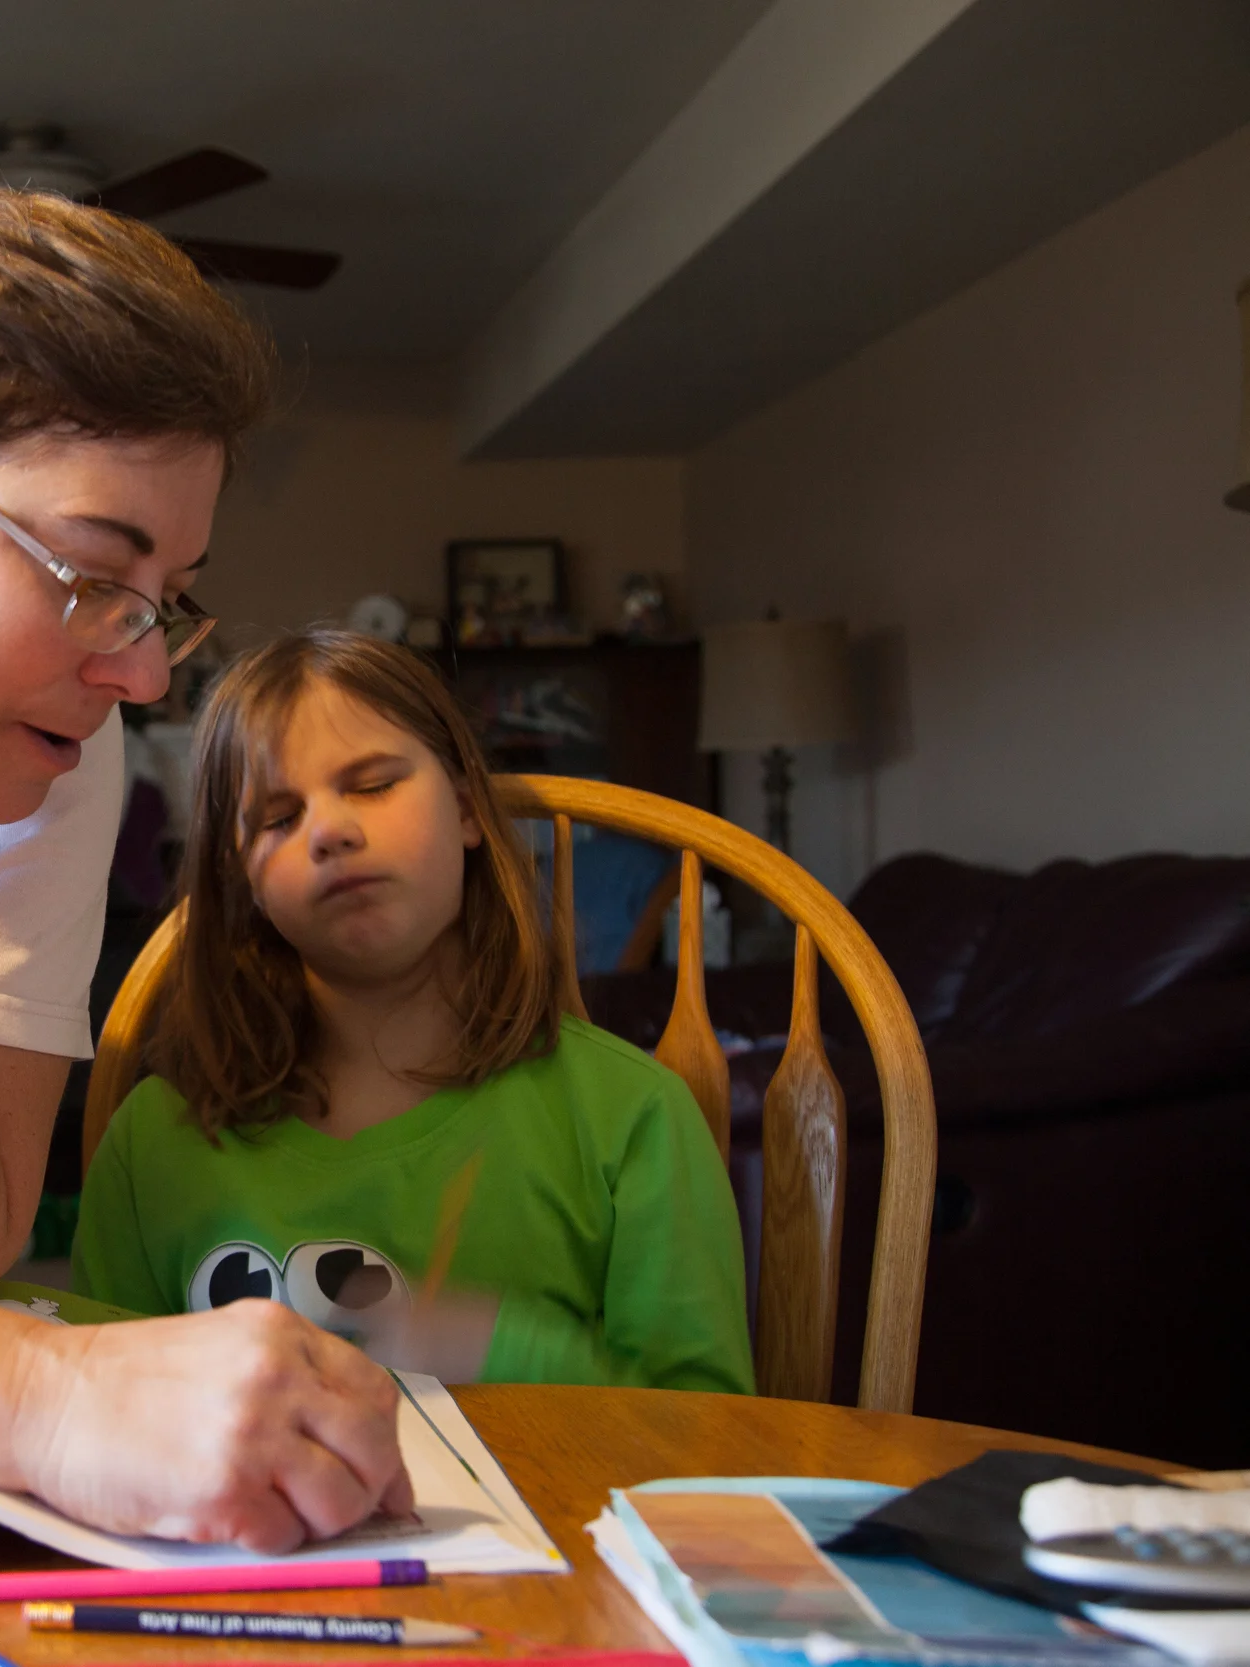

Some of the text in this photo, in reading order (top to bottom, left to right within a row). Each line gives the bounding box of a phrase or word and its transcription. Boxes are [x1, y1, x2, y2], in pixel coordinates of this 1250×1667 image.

[138, 1610, 179, 1633] Arts
[179, 1612, 222, 1635] Fine
[222, 1614, 244, 1635] of
[245, 1615, 324, 1640] Museum
[325, 1616, 393, 1642] County
